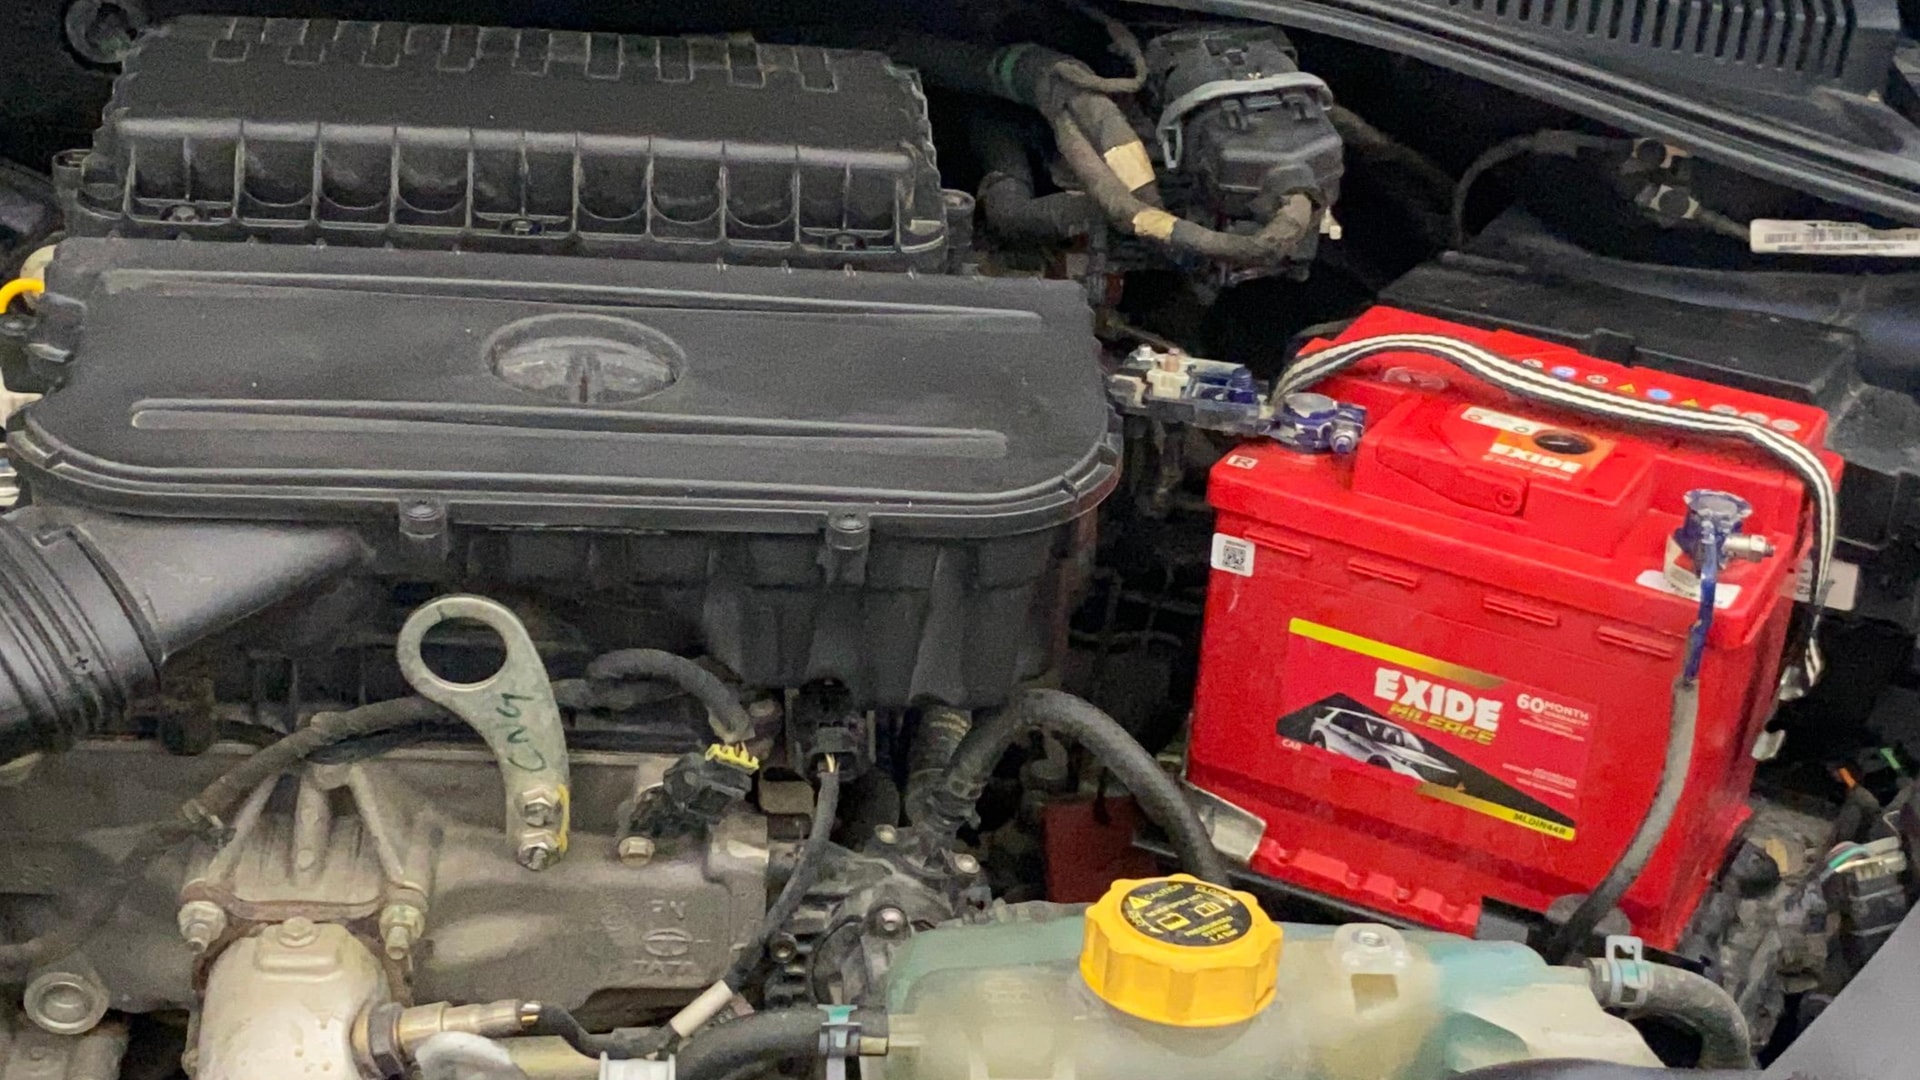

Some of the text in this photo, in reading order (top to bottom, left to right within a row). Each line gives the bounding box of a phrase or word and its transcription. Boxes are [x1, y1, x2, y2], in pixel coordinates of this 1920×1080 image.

[1233, 457, 1253, 467] R
[1489, 442, 1583, 474] EXIDE
[1374, 667, 1503, 732] EXIDE
[1516, 693, 1590, 720] 60 MONTH
[1387, 702, 1497, 745] MILEAGE
[1281, 738, 1302, 751] CAR
[1144, 883, 1184, 900] CAUTION
